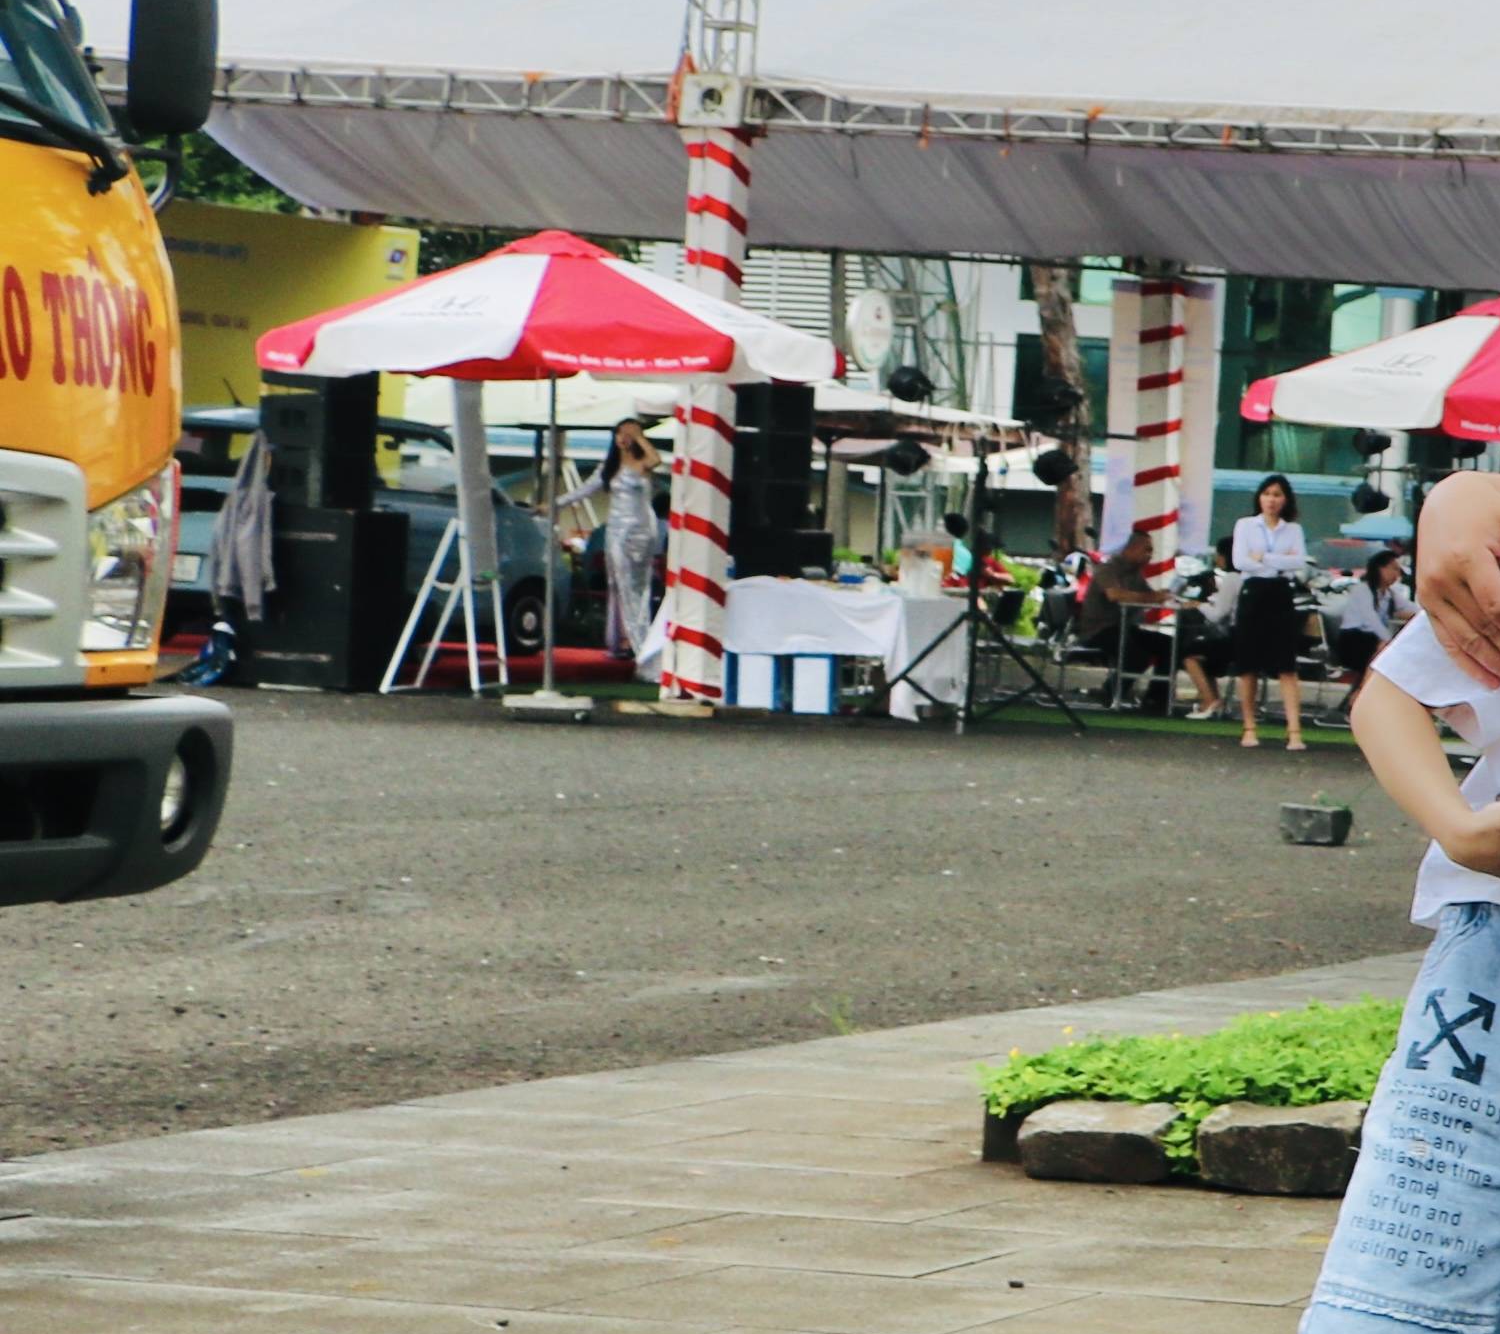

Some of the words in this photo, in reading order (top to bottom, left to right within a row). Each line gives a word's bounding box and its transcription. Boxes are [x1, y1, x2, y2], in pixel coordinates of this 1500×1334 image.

[0, 265, 32, 381] O
[41, 245, 156, 398] THÔNG
[1452, 1162, 1493, 1184] time
[1390, 1192, 1421, 1216] fun
[1426, 1208, 1462, 1227] and
[1440, 1237, 1487, 1258] while
[1416, 1250, 1468, 1278] Tokyo
